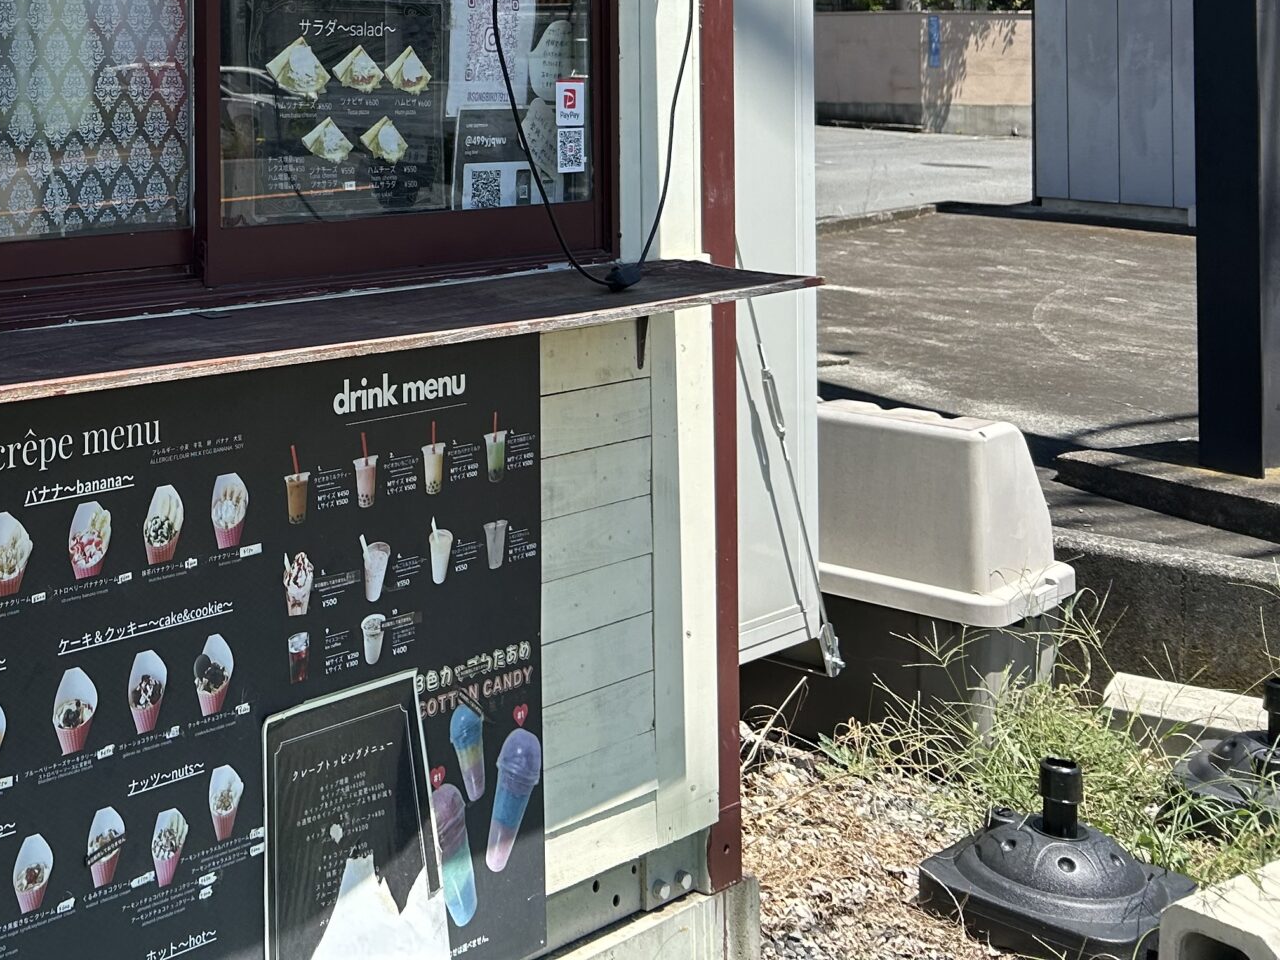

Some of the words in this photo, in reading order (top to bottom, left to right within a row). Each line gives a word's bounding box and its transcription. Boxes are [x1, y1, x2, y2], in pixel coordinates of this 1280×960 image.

[560, 110, 580, 121] PayPay
[333, 373, 397, 415] drink
[402, 373, 466, 403] menu
[82, 420, 161, 456] menu
[396, 578, 410, 587] ¥550
[322, 598, 338, 607] ¥500
[392, 645, 407, 655] ¥400
[482, 665, 533, 698] CANDY
[292, 741, 394, 781] クレープトッピングメニュー
